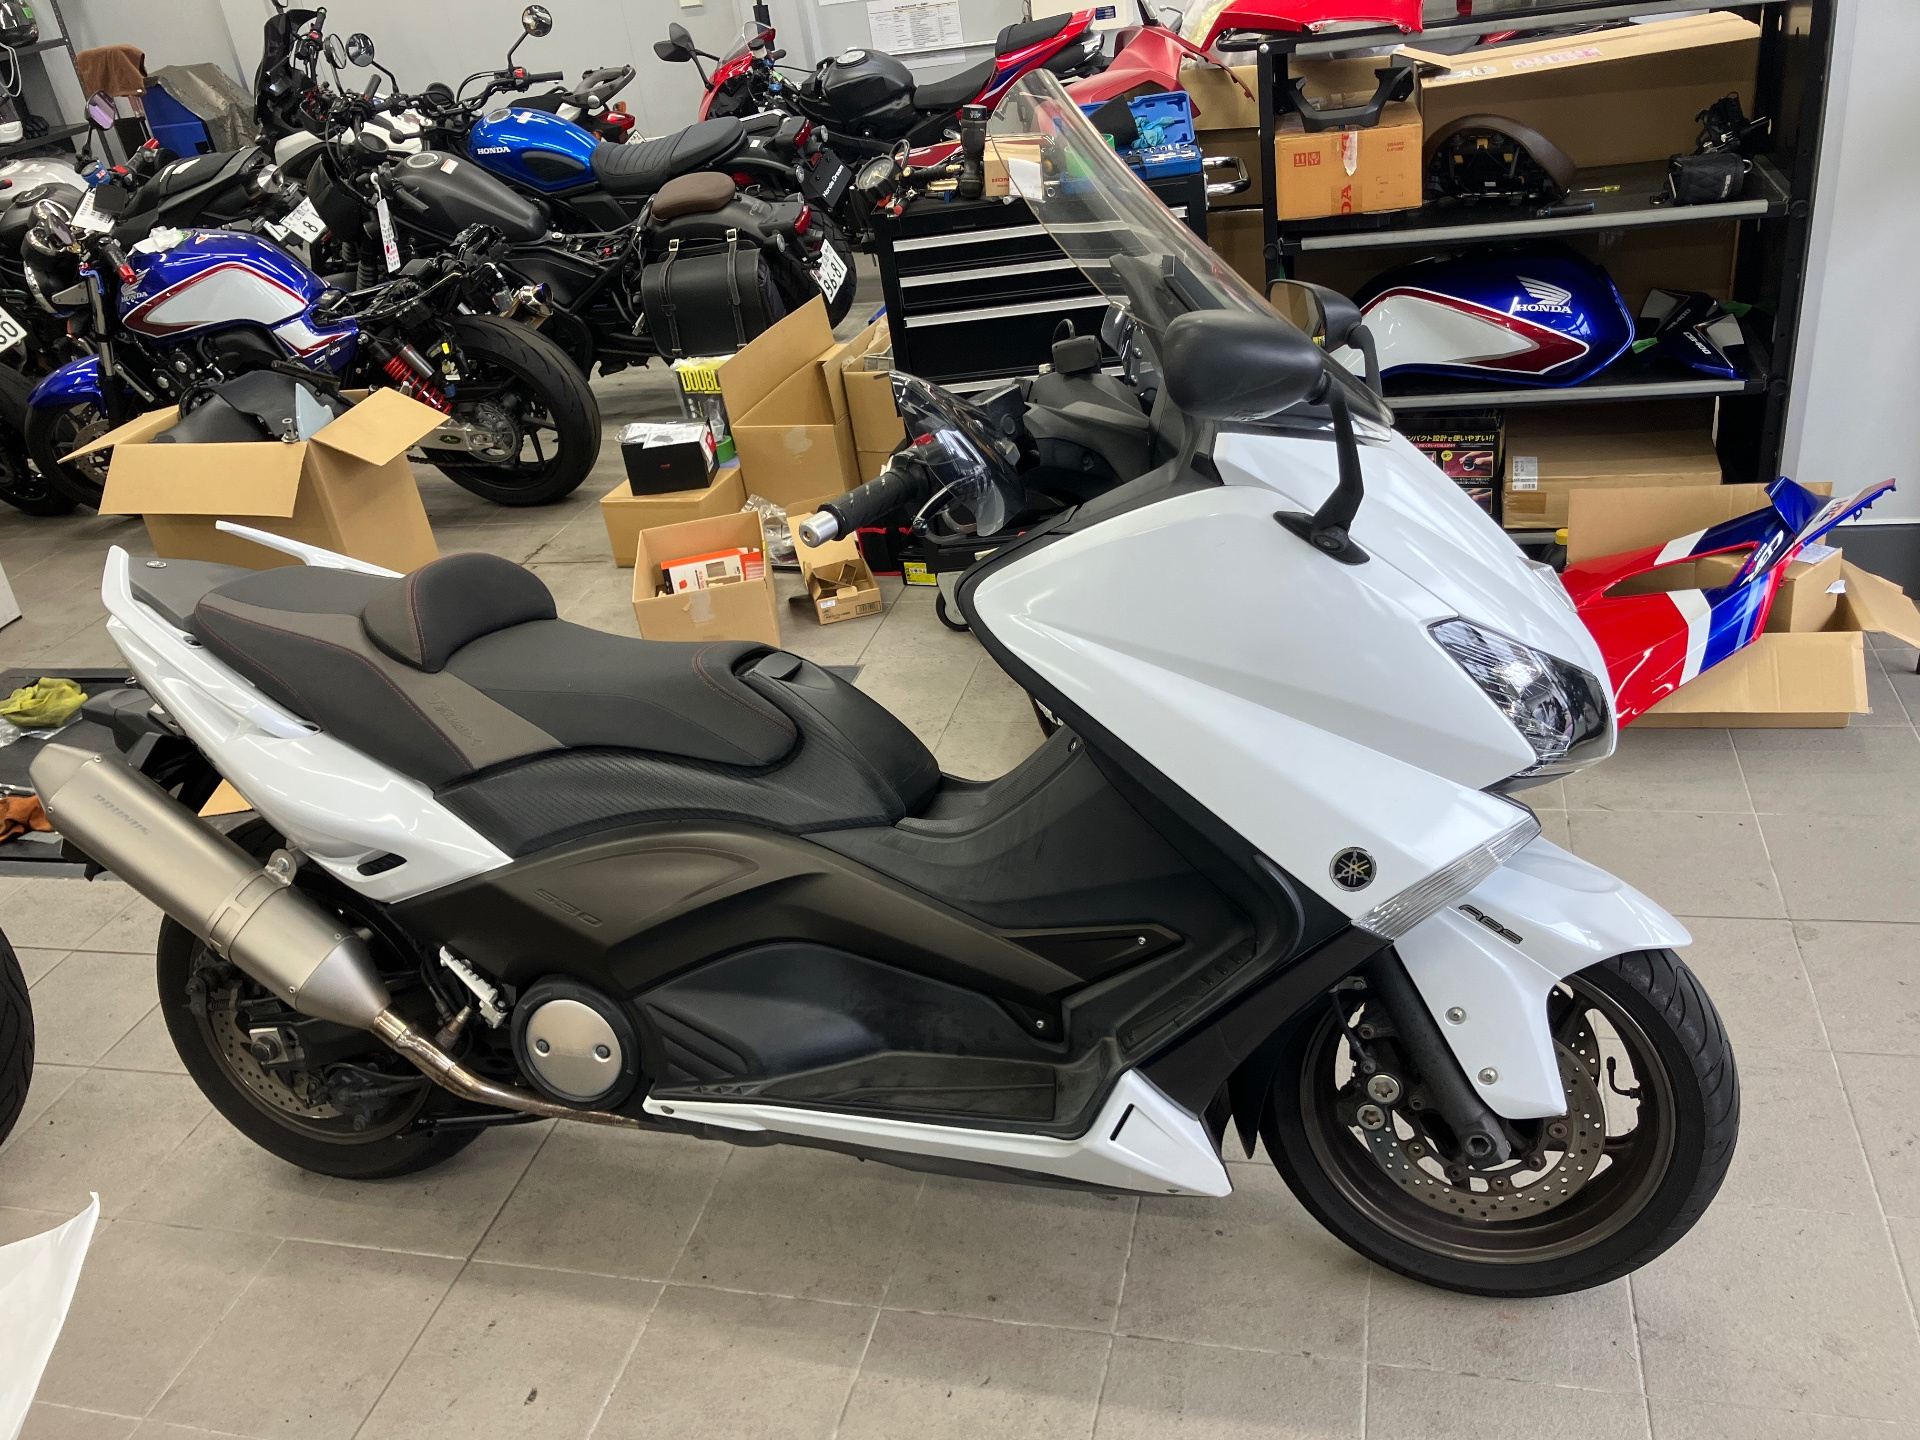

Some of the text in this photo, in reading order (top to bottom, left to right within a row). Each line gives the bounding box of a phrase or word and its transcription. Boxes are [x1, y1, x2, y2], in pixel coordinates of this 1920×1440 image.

[477, 146, 511, 155] HONDA
[991, 176, 1010, 184] HON
[120, 291, 149, 303] HONDA
[1514, 303, 1573, 314] HONDA
[314, 346, 341, 365] CB00
[680, 369, 722, 392] DOUBL
[1457, 903, 1524, 945] ABS
